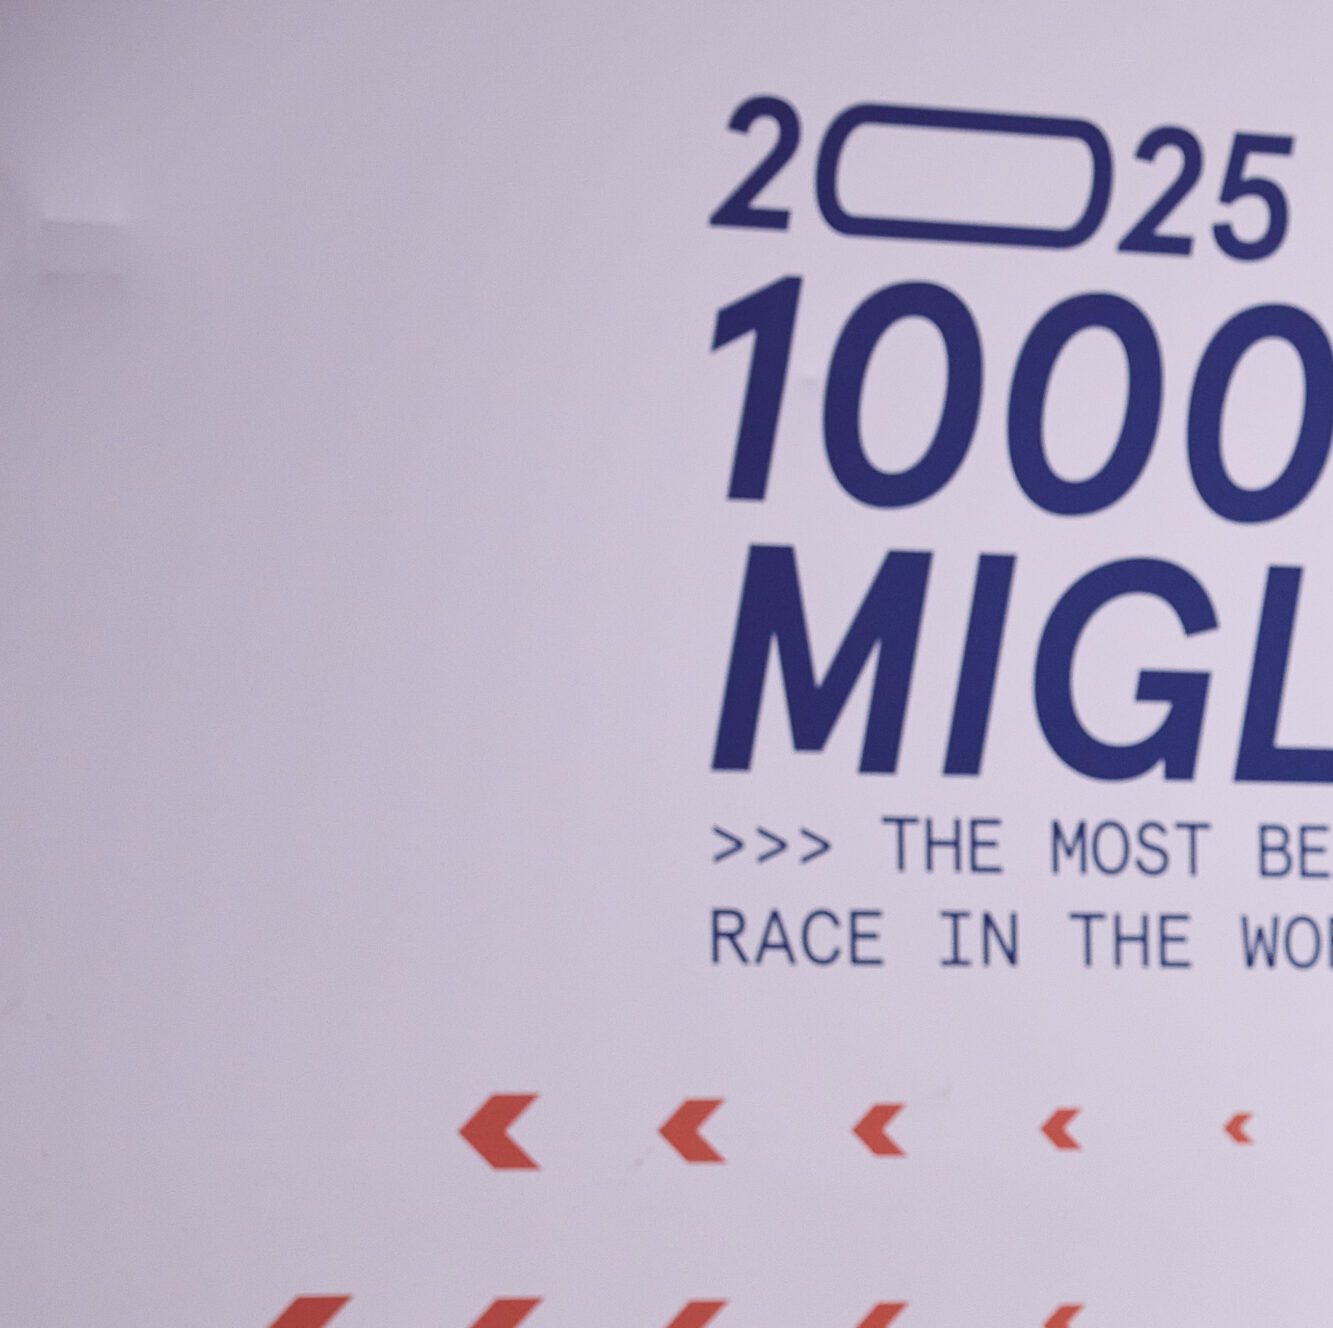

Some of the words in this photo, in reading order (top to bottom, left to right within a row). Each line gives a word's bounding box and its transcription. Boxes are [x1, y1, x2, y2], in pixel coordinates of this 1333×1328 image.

[881, 818, 1003, 874] THE
[1052, 822, 1211, 878] MOST
[710, 909, 883, 966] RACE
[939, 913, 1018, 968] IN
[1069, 916, 1192, 970] THE
